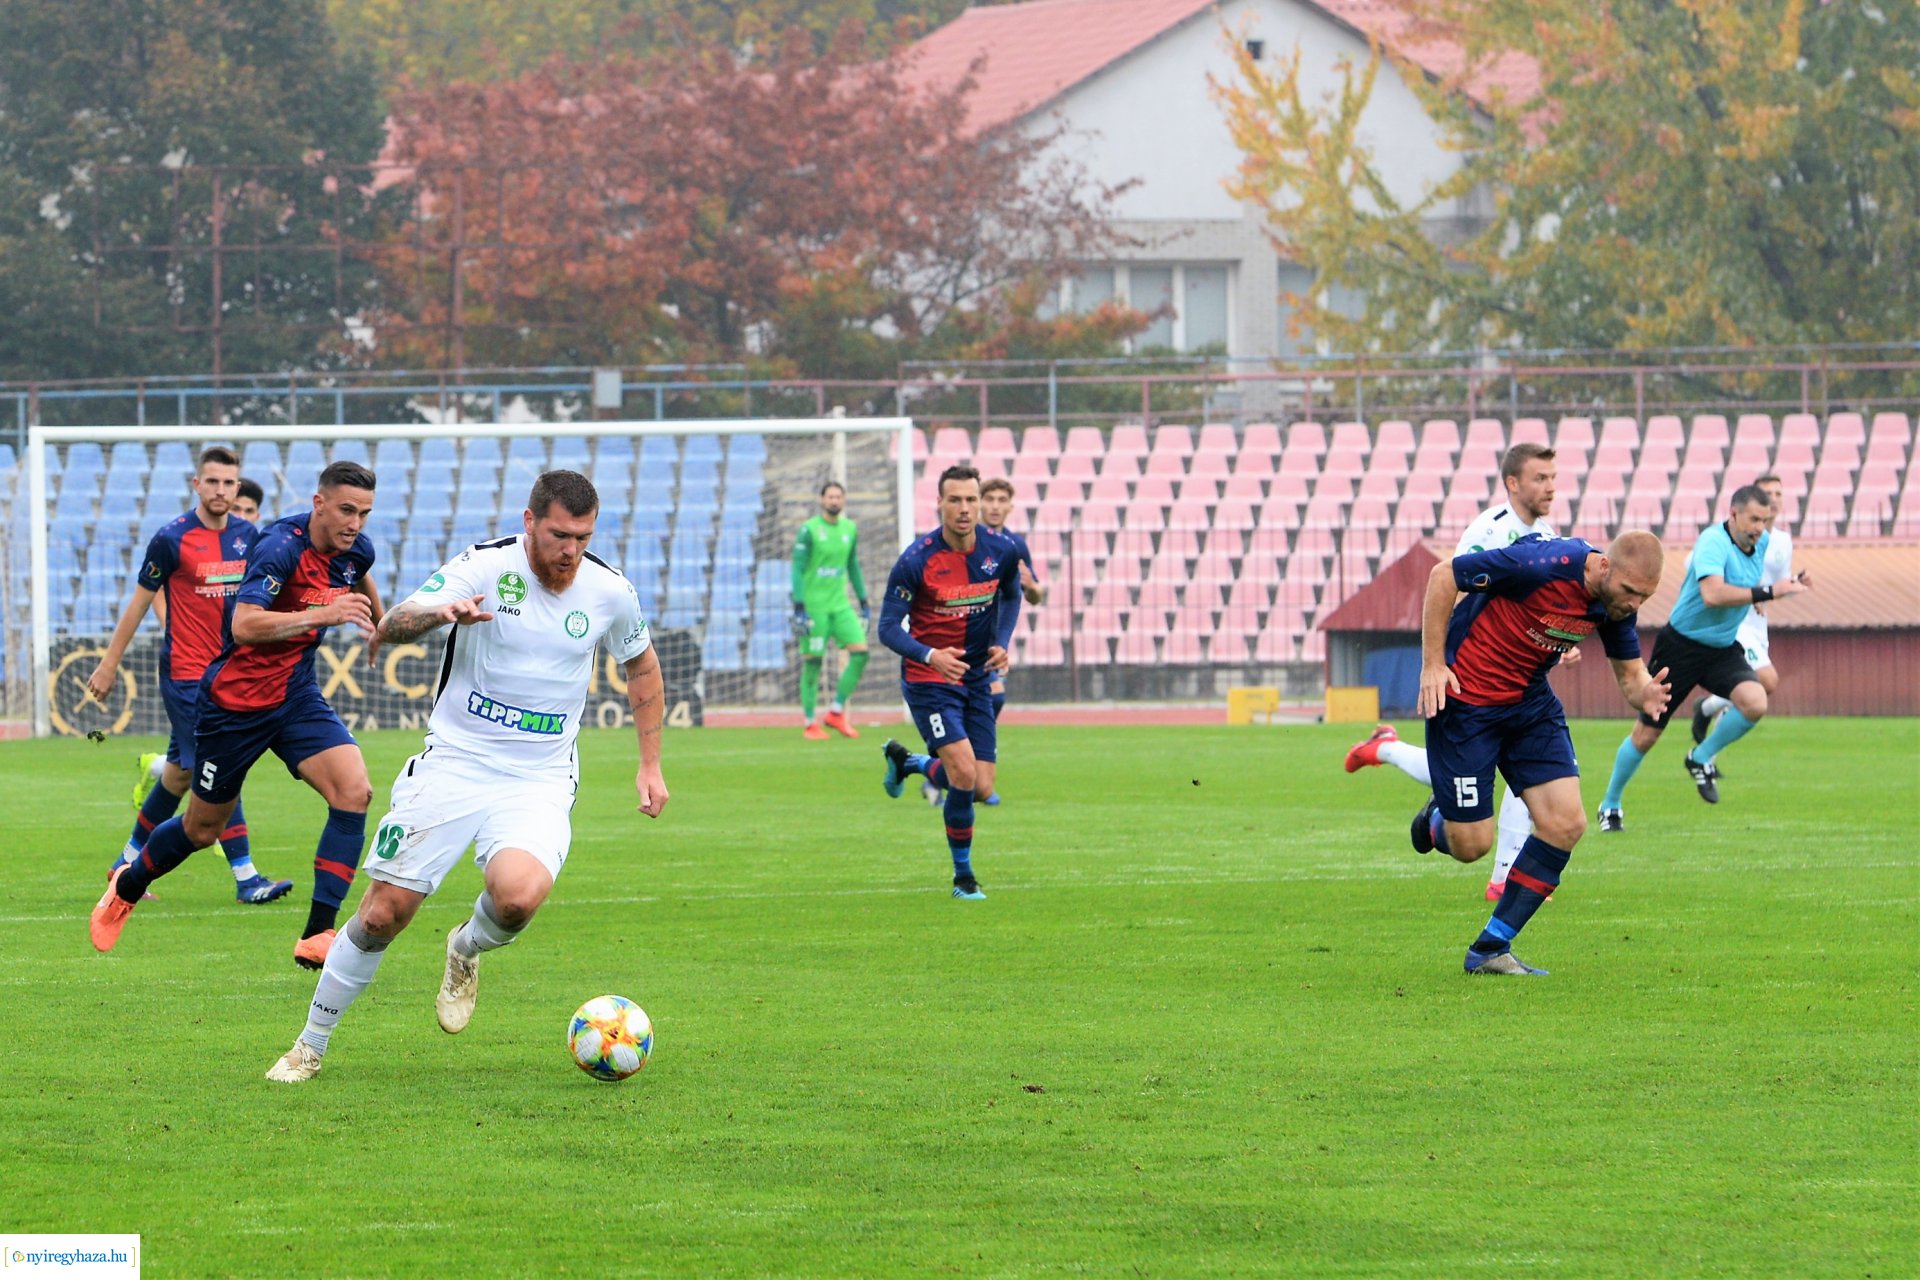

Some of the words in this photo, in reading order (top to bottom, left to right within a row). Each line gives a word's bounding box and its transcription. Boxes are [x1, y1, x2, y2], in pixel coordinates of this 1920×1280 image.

[497, 605, 521, 616] JAKO
[929, 713, 946, 739] 8
[200, 761, 218, 791] 5
[1453, 776, 1479, 808] 15
[376, 823, 405, 860] 16
[312, 1000, 339, 1015] JAKO
